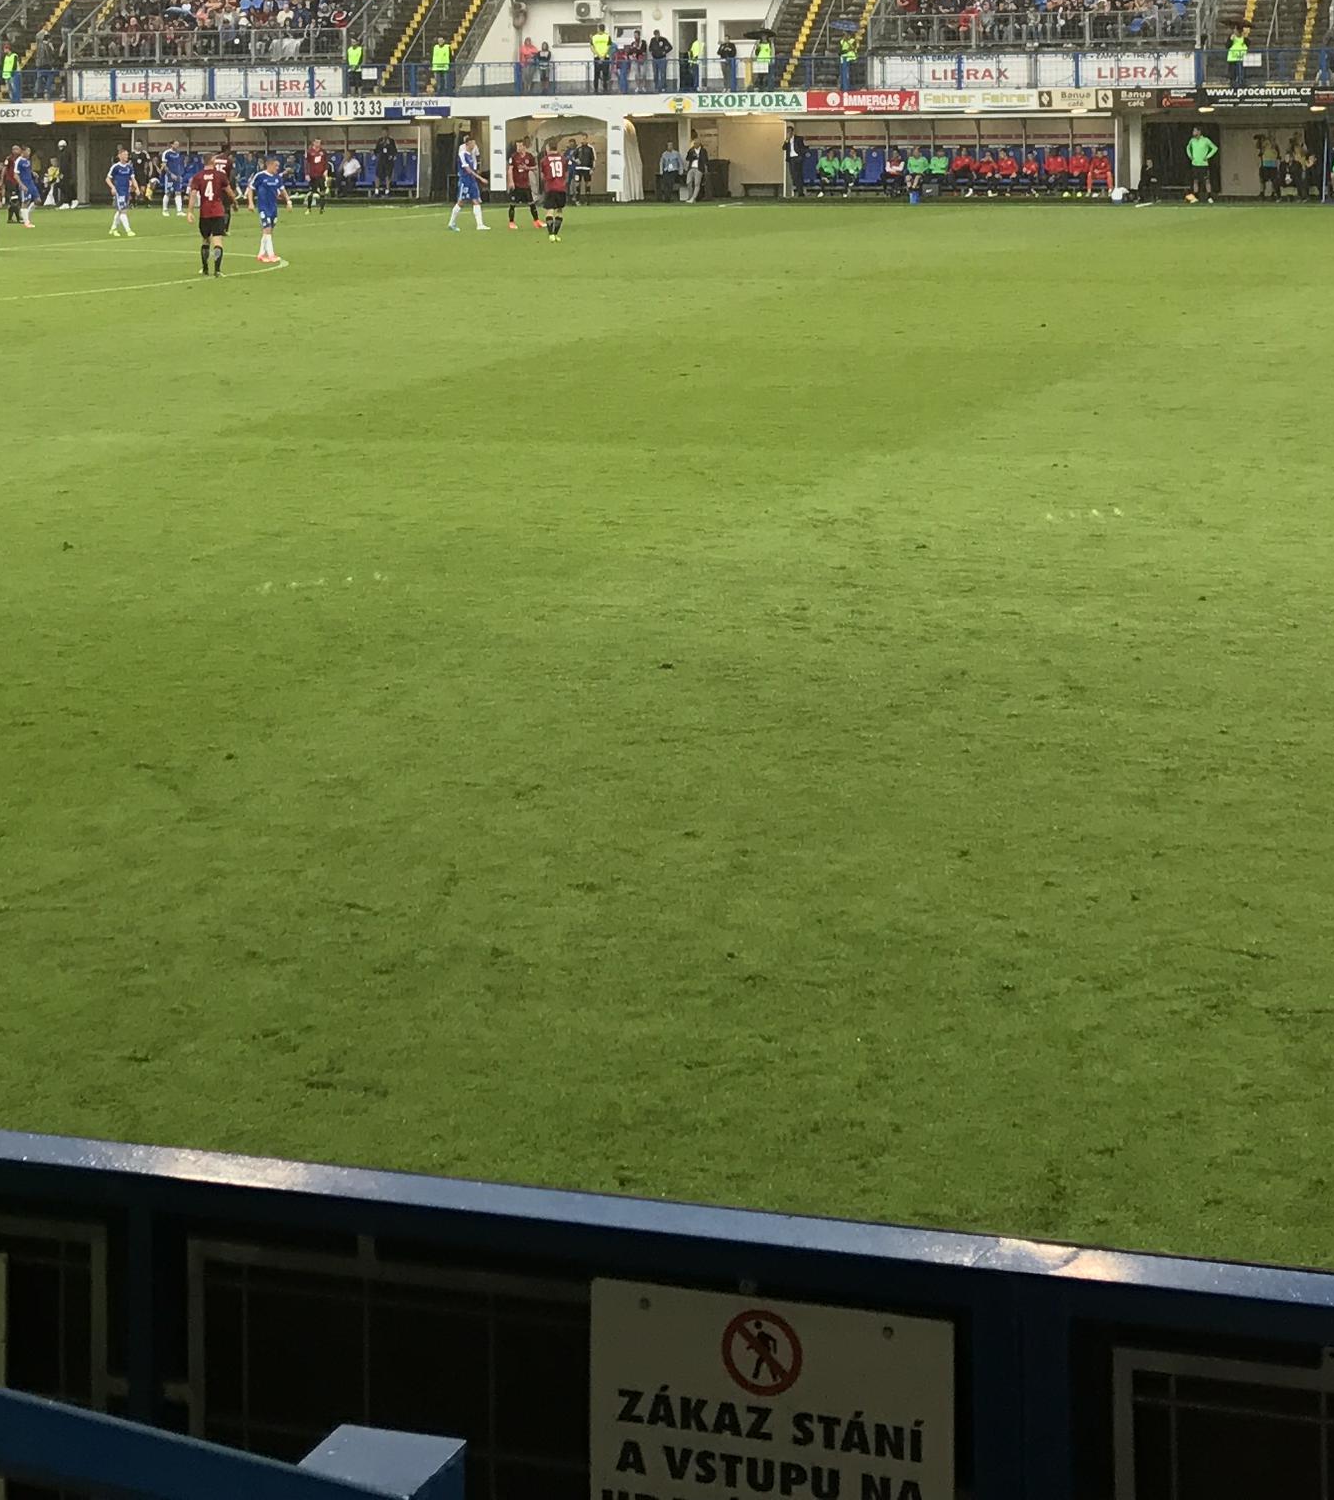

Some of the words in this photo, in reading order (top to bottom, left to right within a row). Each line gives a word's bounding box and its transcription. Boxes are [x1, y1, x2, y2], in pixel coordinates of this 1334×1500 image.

[931, 68, 1010, 81] LIBRAX
[1097, 66, 1178, 80] LIBRAX
[121, 81, 187, 94] LIBRAX
[259, 79, 327, 92] LIBRAX
[1060, 91, 1091, 99] Banua
[1121, 90, 1152, 99] Banua
[1206, 88, 1311, 97] www.procentrum.cz
[164, 101, 238, 112] PROPAMO
[697, 93, 803, 108] EKOFLORA
[77, 104, 126, 116] UTALENTA
[251, 102, 279, 118] BLESK
[283, 101, 304, 117] TAXI
[313, 101, 334, 116] 800
[338, 101, 348, 116] 11
[353, 101, 365, 115] 33
[369, 101, 382, 115] 33
[549, 160, 563, 178] 19
[204, 181, 214, 201] 4
[617, 1384, 774, 1441] ZÁKAZ
[791, 1411, 925, 1463] STÁNÍ
[615, 1440, 647, 1476] A
[662, 1445, 841, 1500] VSTUPU
[861, 1473, 924, 1500] NA
